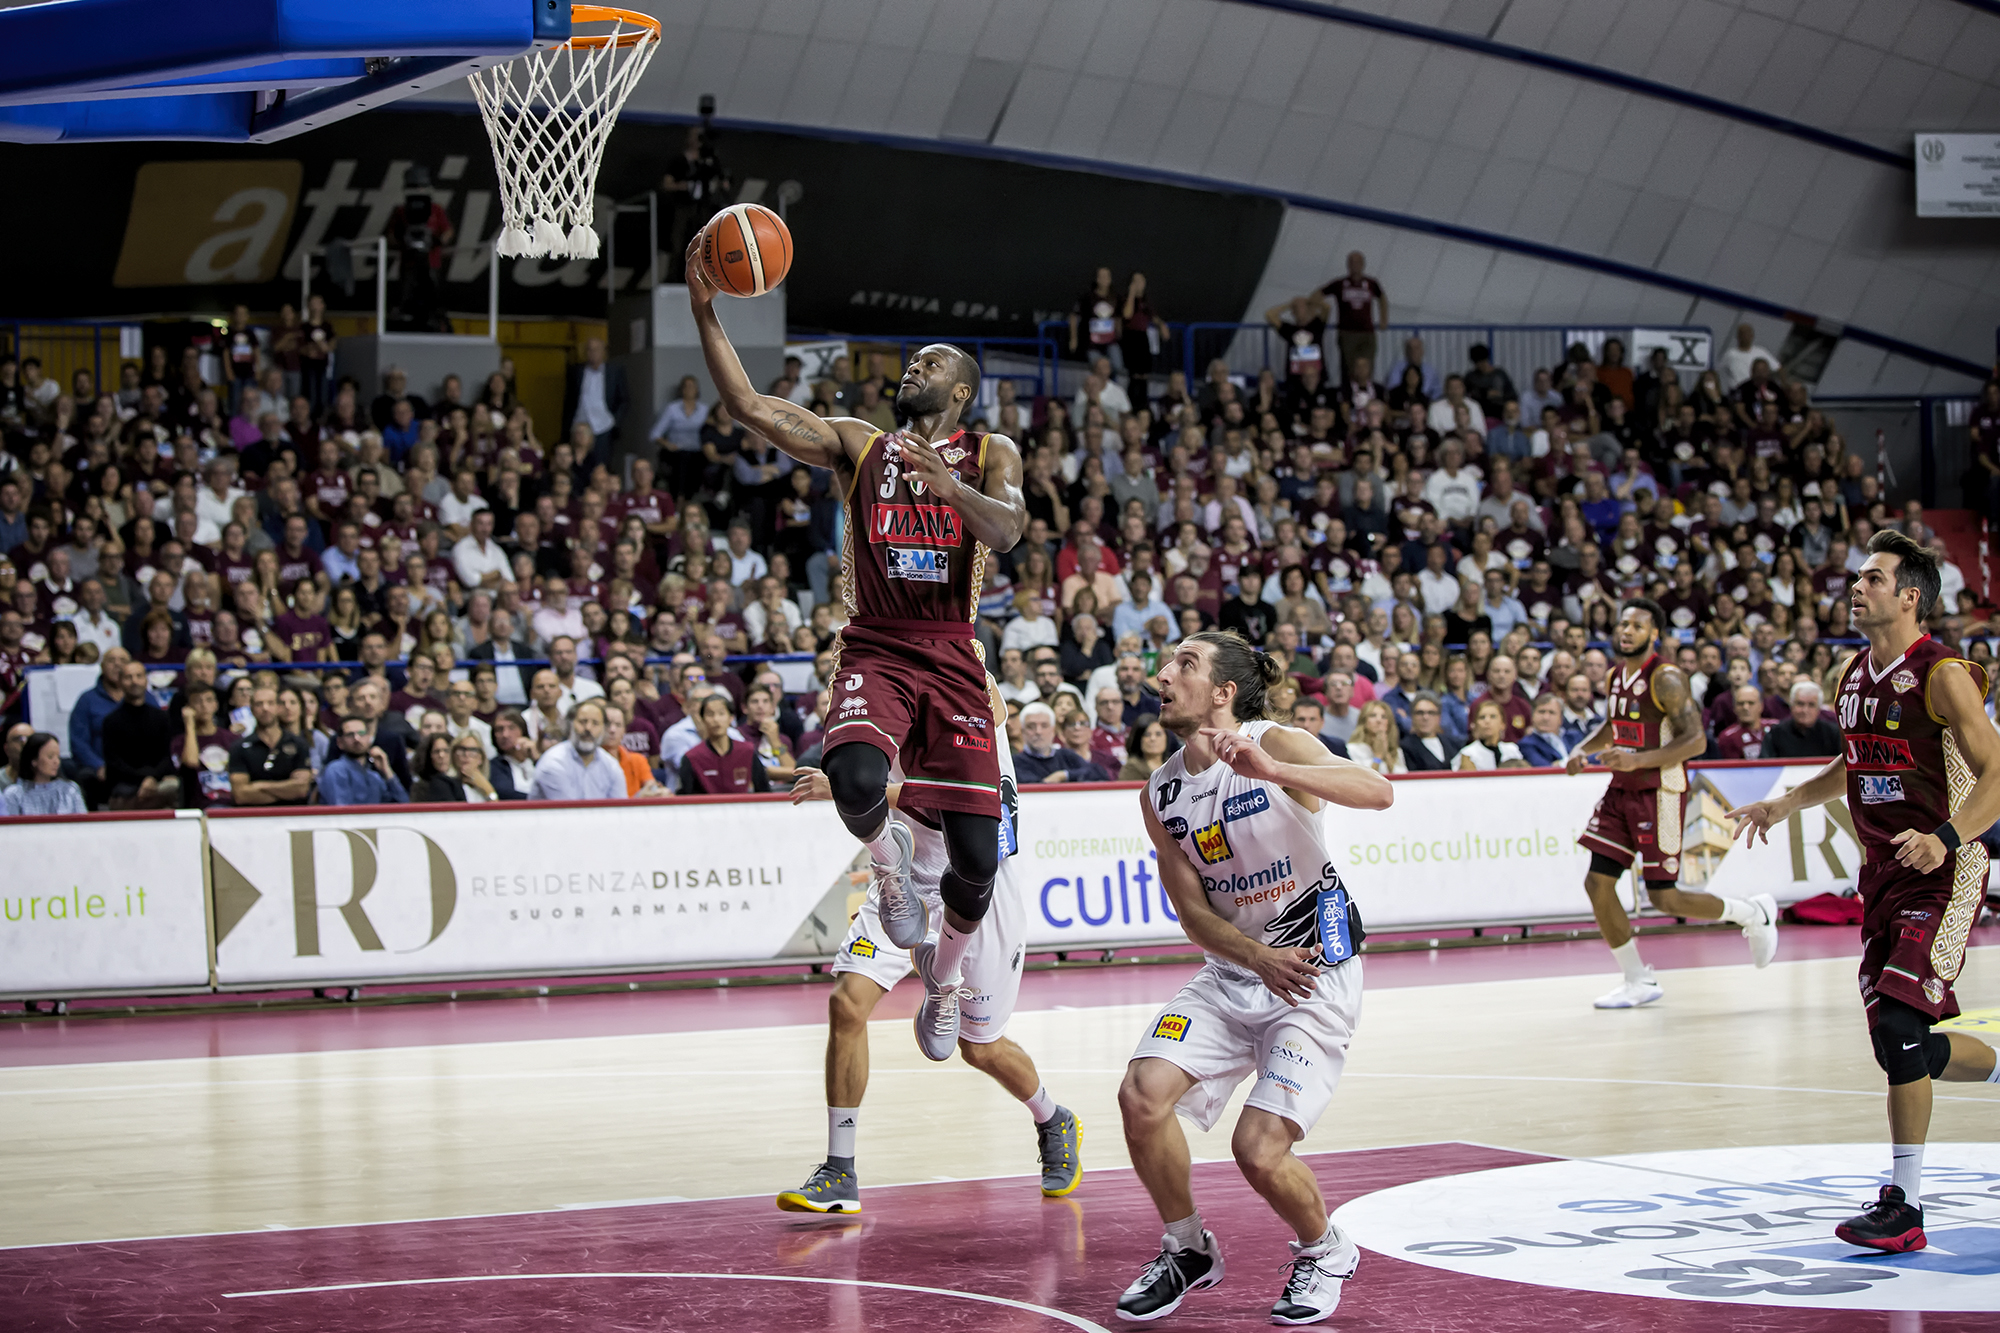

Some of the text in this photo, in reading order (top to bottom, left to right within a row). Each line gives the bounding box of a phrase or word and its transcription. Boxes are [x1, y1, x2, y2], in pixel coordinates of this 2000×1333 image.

[704, 234, 726, 287] molten
[850, 290, 941, 313] ATTIVA
[950, 301, 999, 320] SPA
[1669, 334, 1707, 367] X
[879, 463, 899, 499] 3
[876, 508, 957, 540] UMANA
[887, 548, 936, 571] RBM
[839, 708, 868, 719] errea
[1838, 693, 1860, 729] 30
[956, 736, 989, 749] UMANA
[1157, 778, 1182, 812] 10
[1191, 787, 1218, 804] SPALDING
[1859, 776, 1892, 795] RBM
[1035, 837, 1145, 859] COOPERATIVA
[1200, 833, 1223, 854] MD
[1204, 856, 1292, 893] Dolomiti
[3, 885, 147, 921] urale.it
[1234, 880, 1296, 908] energia
[510, 901, 751, 920] SUOR ARMANDA
[1323, 894, 1345, 956] TRENTINO
[1160, 1020, 1183, 1032] MD
[1270, 1045, 1314, 1067] CAVIT
[1266, 1071, 1303, 1092] Dolomiti
[1275, 1083, 1300, 1096] energia
